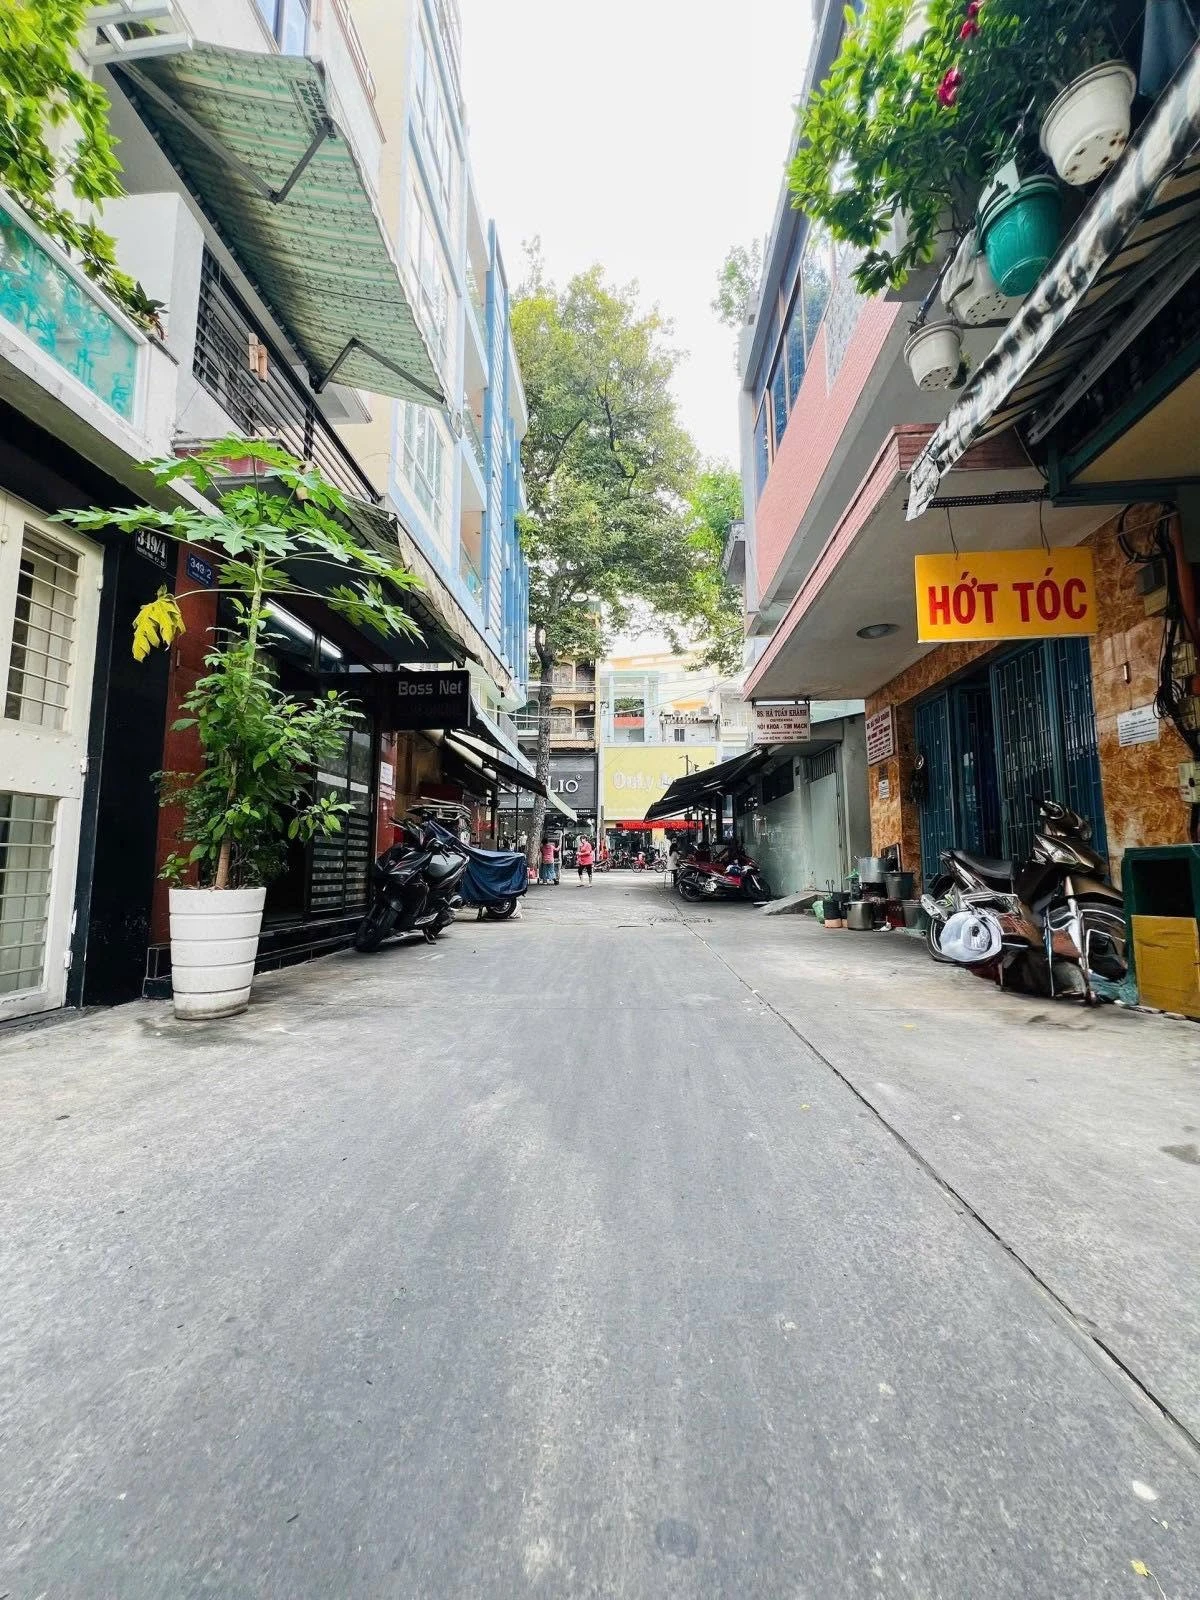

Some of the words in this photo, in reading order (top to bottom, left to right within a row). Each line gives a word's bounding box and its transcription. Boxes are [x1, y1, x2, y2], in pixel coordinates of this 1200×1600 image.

[137, 530, 166, 559] 349/4
[928, 571, 998, 625] HỚT
[1012, 567, 1088, 623] TÓC
[398, 680, 433, 696] Boss
[439, 679, 463, 695] Net
